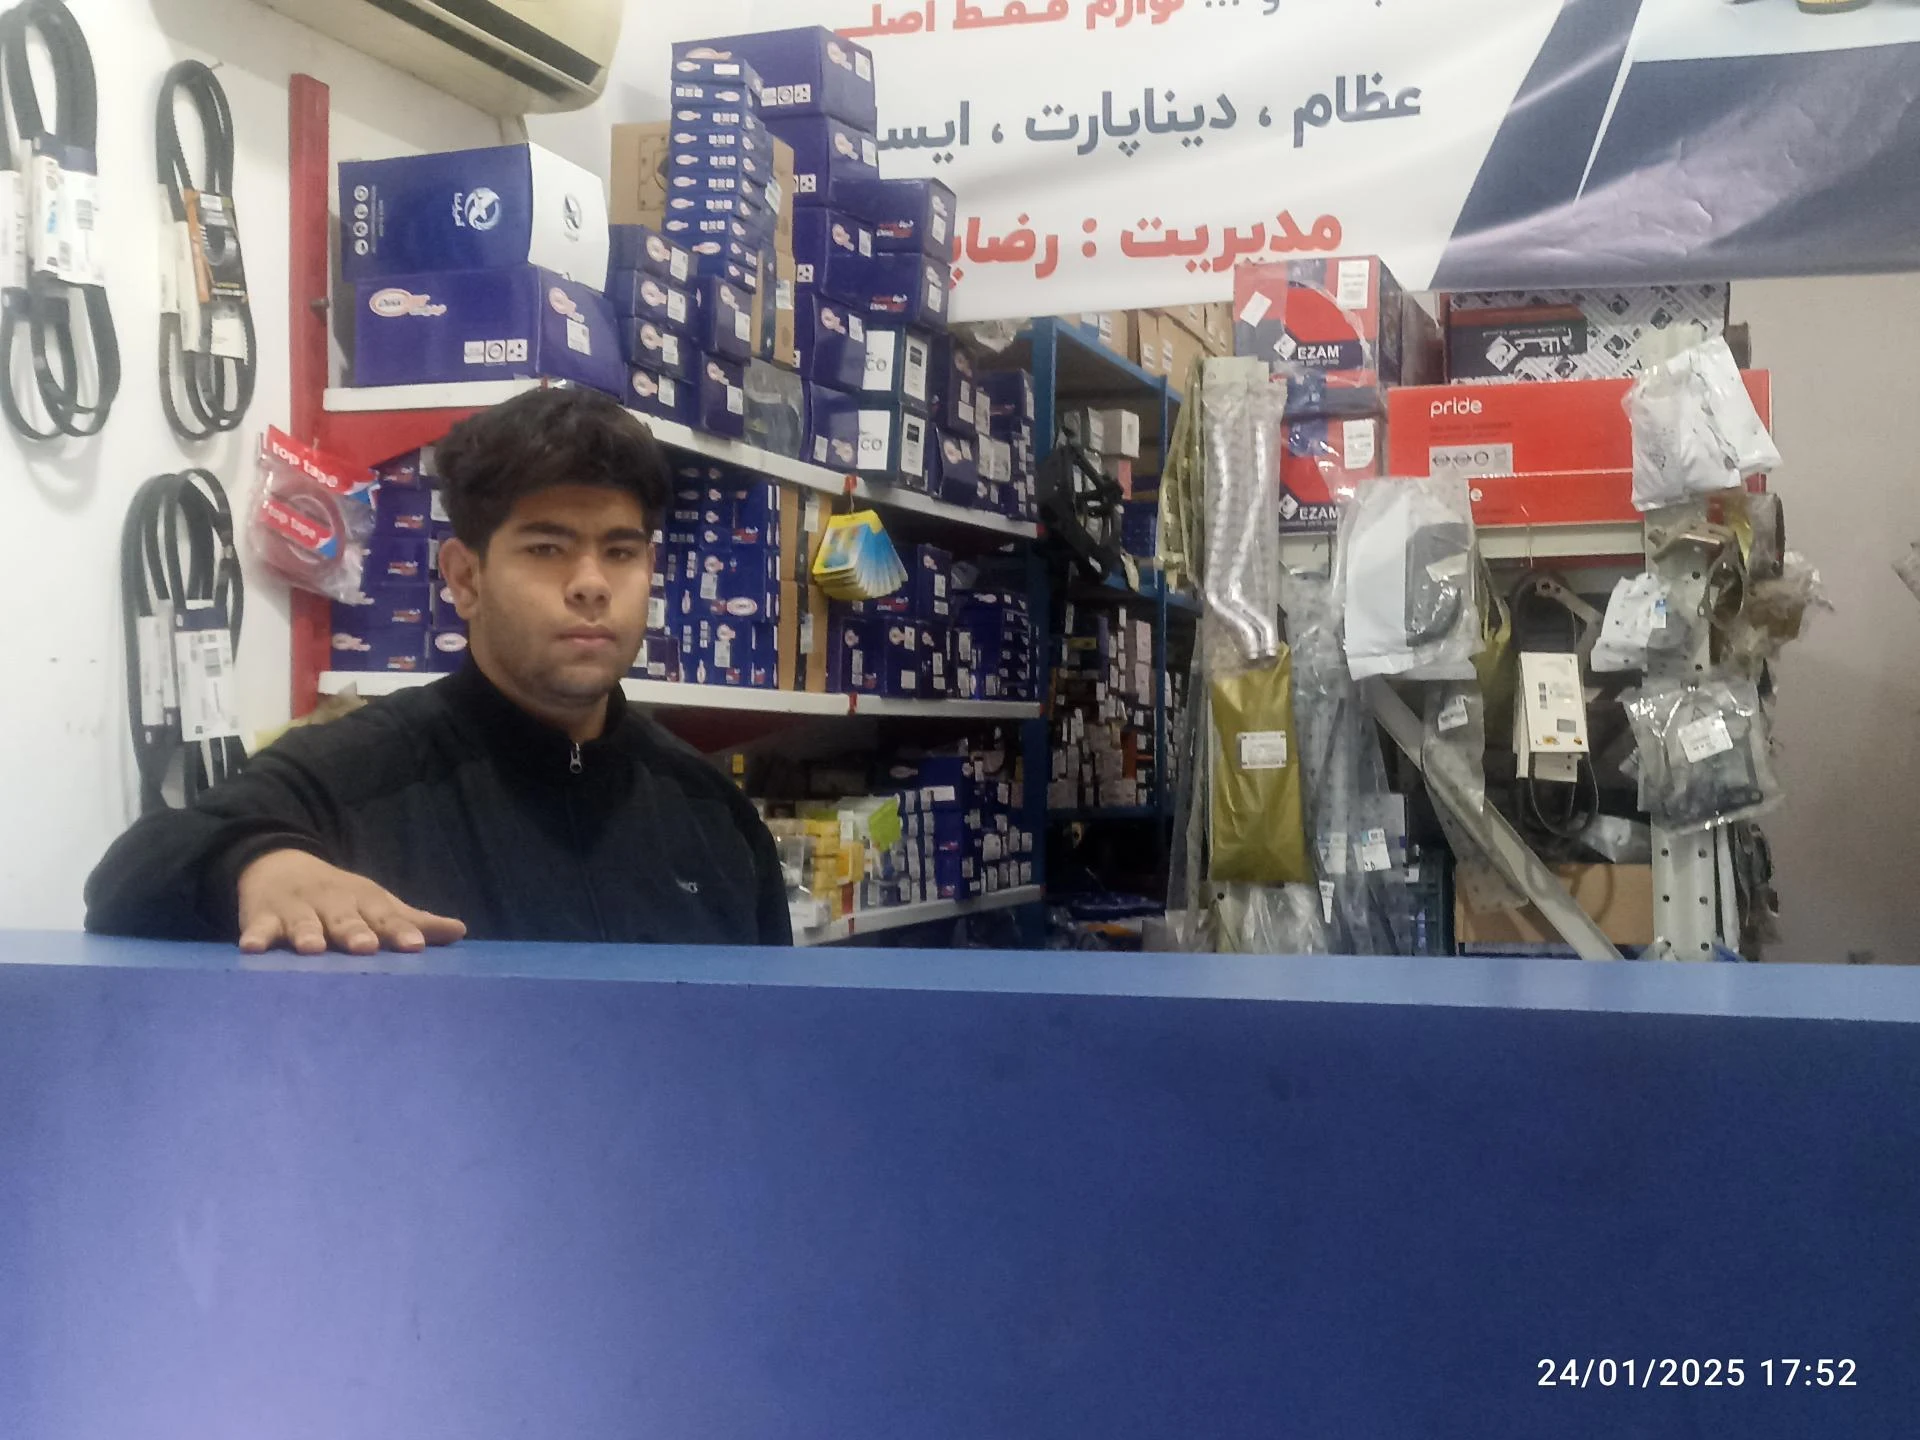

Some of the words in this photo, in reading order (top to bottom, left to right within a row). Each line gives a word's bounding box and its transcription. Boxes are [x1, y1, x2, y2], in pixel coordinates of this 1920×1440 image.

[1025, 88, 1238, 157] دیناپارت
[1293, 72, 1422, 148] عظام
[1119, 209, 1343, 273] مدیریت
[1297, 345, 1340, 360] EZAM
[1430, 397, 1483, 418] pride
